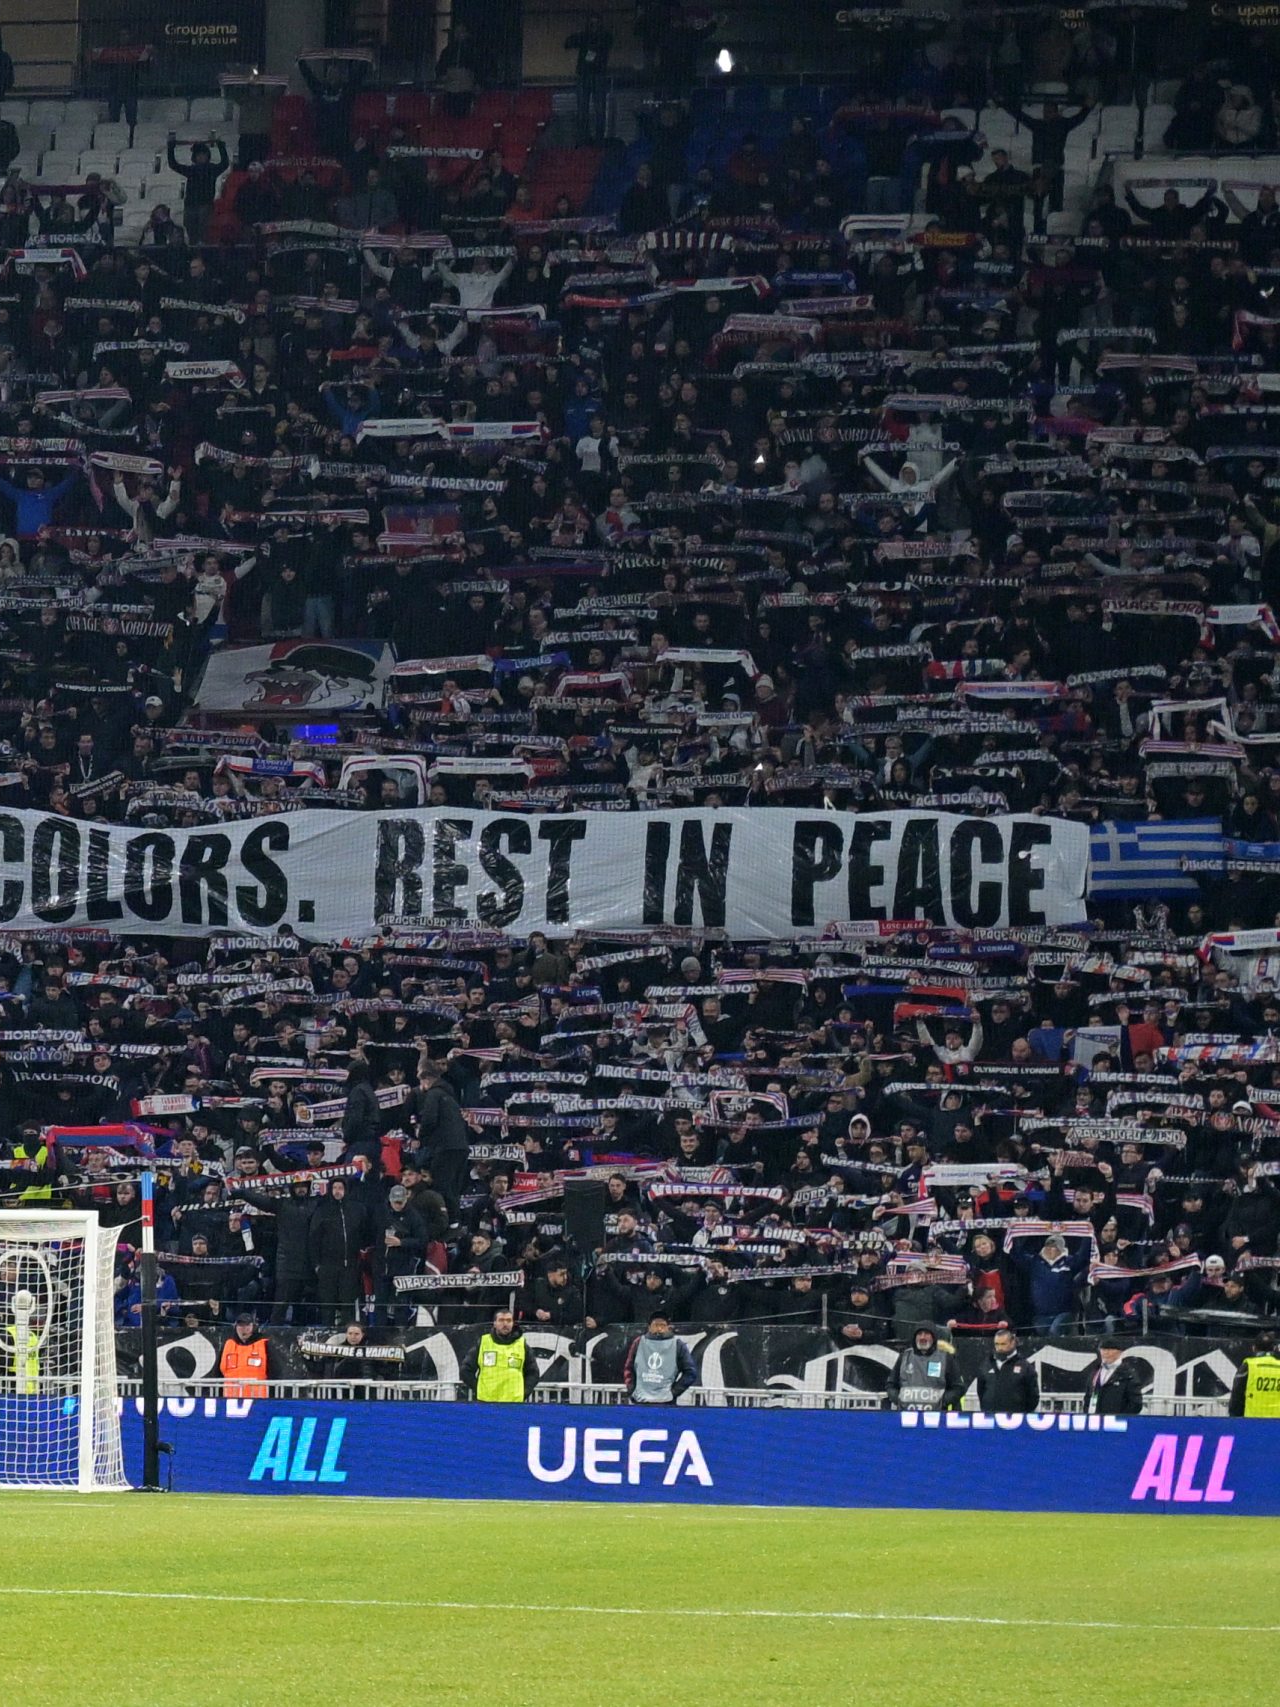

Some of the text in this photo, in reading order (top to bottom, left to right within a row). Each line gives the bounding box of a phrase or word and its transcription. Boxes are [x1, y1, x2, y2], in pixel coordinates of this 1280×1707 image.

[165, 23, 238, 37] Groupama
[191, 37, 238, 45] STADIUM
[172, 365, 221, 378] LYONNAIS
[374, 818, 588, 928] REST
[641, 820, 733, 925] IN
[791, 820, 1054, 927] PEACE
[685, 984, 718, 997] NORD
[4, 1029, 39, 1042] NORD
[118, 1043, 161, 1055] GONES
[972, 1065, 1060, 1075] OLYMPIQUE LYONNAIS
[1136, 1072, 1179, 1085] NORD
[596, 1098, 629, 1111] NORD
[473, 1114, 602, 1128] VIRAGE NORD LYON
[232, 1164, 359, 1189] VIRAGE NORD
[650, 1183, 783, 1202] VIRAGE NORD
[505, 1211, 536, 1223] BAD
[967, 1217, 1006, 1232] NORD
[763, 1227, 806, 1243] GONES
[394, 1270, 521, 1292] VIRAGE NORD LYON
[902, 1389, 943, 1402] PITCH
[247, 1416, 348, 1482] ALL
[526, 1425, 715, 1488] UEFA
[1131, 1433, 1236, 1503] ALL
